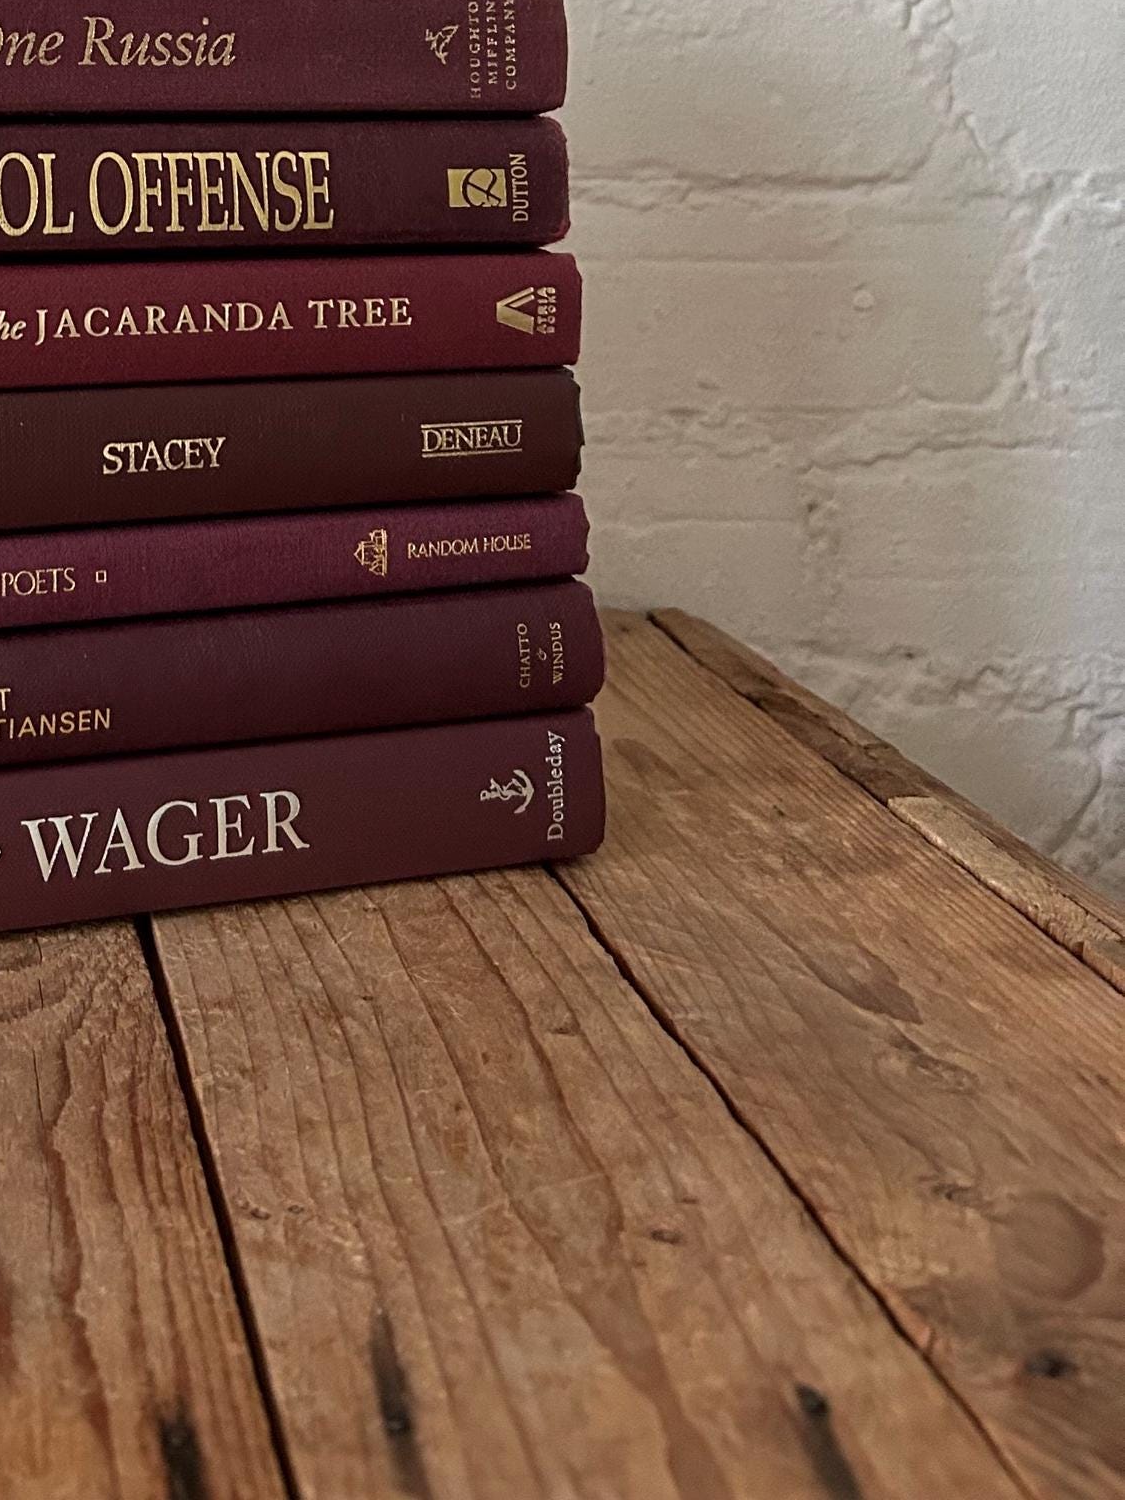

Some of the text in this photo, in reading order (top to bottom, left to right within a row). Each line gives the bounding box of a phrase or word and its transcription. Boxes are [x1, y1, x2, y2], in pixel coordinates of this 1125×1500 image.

[78, 16, 237, 68] Russia
[485, 0, 498, 85] MIFFLIN
[87, 150, 335, 235] OFFENSE
[508, 153, 530, 222] DUTTON
[34, 301, 294, 346] JACARANDA
[308, 297, 413, 331] TREE
[535, 287, 548, 334] ATRIA
[102, 436, 227, 476] STACEY
[422, 424, 523, 453] DENEAU
[407, 532, 532, 560] RANDOM HOUSE
[0, 566, 77, 598] POETS
[516, 622, 531, 688] CHATTO
[549, 621, 564, 684] WINDUS
[545, 730, 566, 842] Doubleday
[20, 788, 311, 883] WAGER
